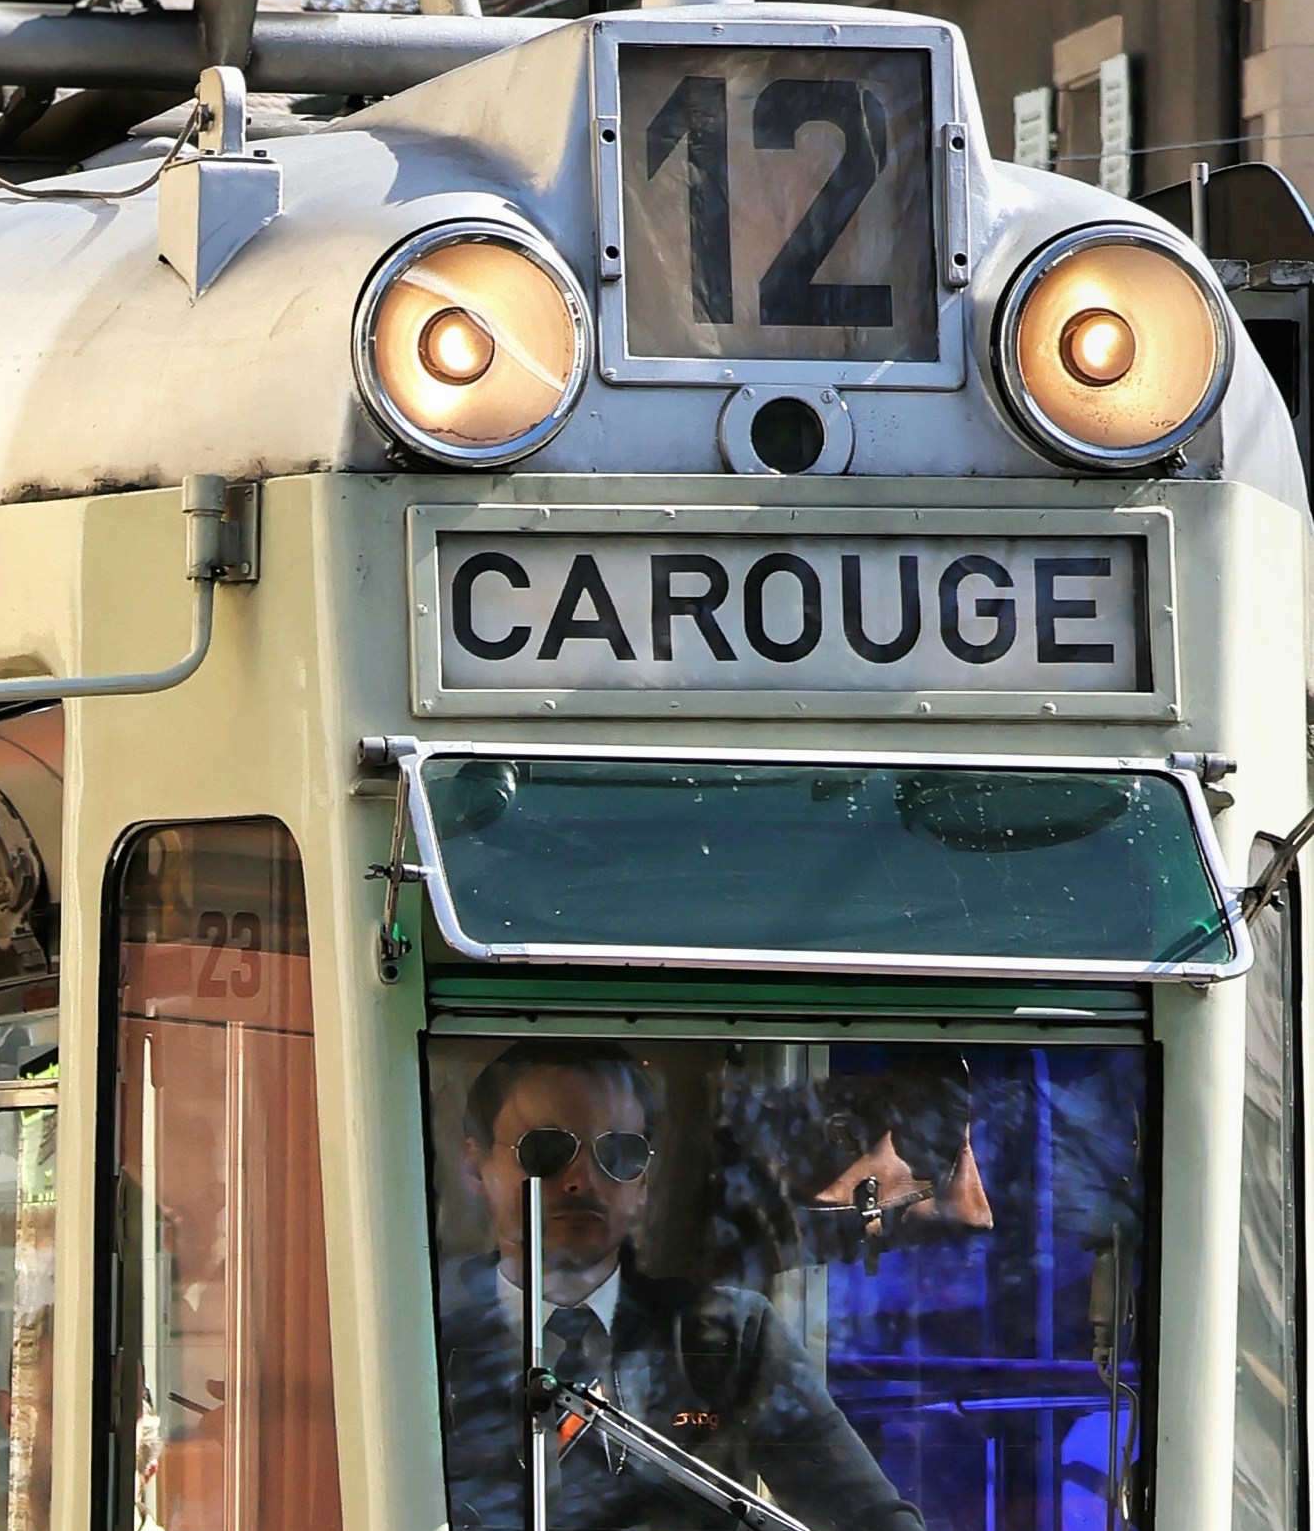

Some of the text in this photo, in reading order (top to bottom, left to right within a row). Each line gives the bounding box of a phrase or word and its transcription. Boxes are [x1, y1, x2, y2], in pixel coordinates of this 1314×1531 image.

[647, 76, 893, 328] 12
[451, 551, 1114, 664] CAROUGE
[197, 910, 261, 999] 23
